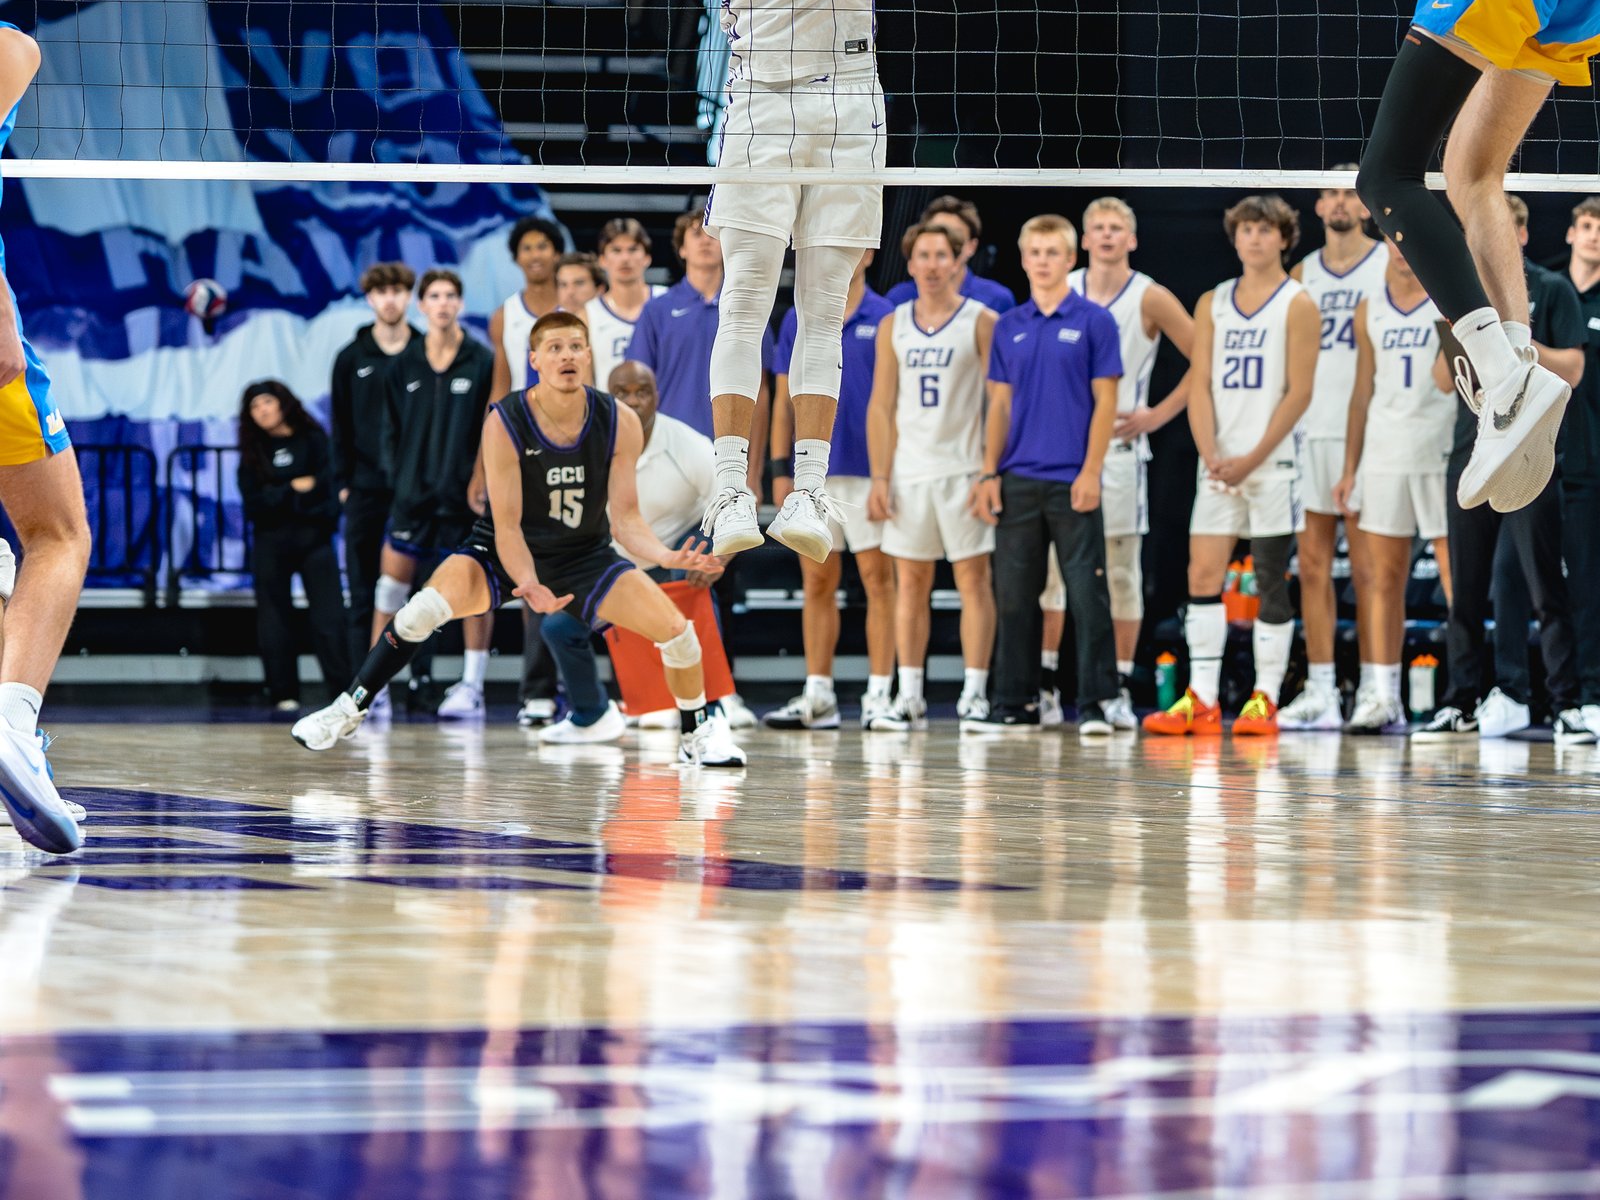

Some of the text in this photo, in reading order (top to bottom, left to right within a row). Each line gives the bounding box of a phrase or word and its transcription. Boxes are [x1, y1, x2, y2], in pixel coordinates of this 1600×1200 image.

[1320, 289, 1363, 314] GCU
[1223, 328, 1268, 350] GCU
[1319, 316, 1357, 351] 24
[1382, 326, 1432, 351] GCU
[906, 346, 954, 369] GCU
[1222, 355, 1264, 390] 20
[1400, 353, 1413, 389] 1
[919, 373, 940, 408] 6
[545, 464, 586, 487] GCU
[548, 487, 586, 530] 15
